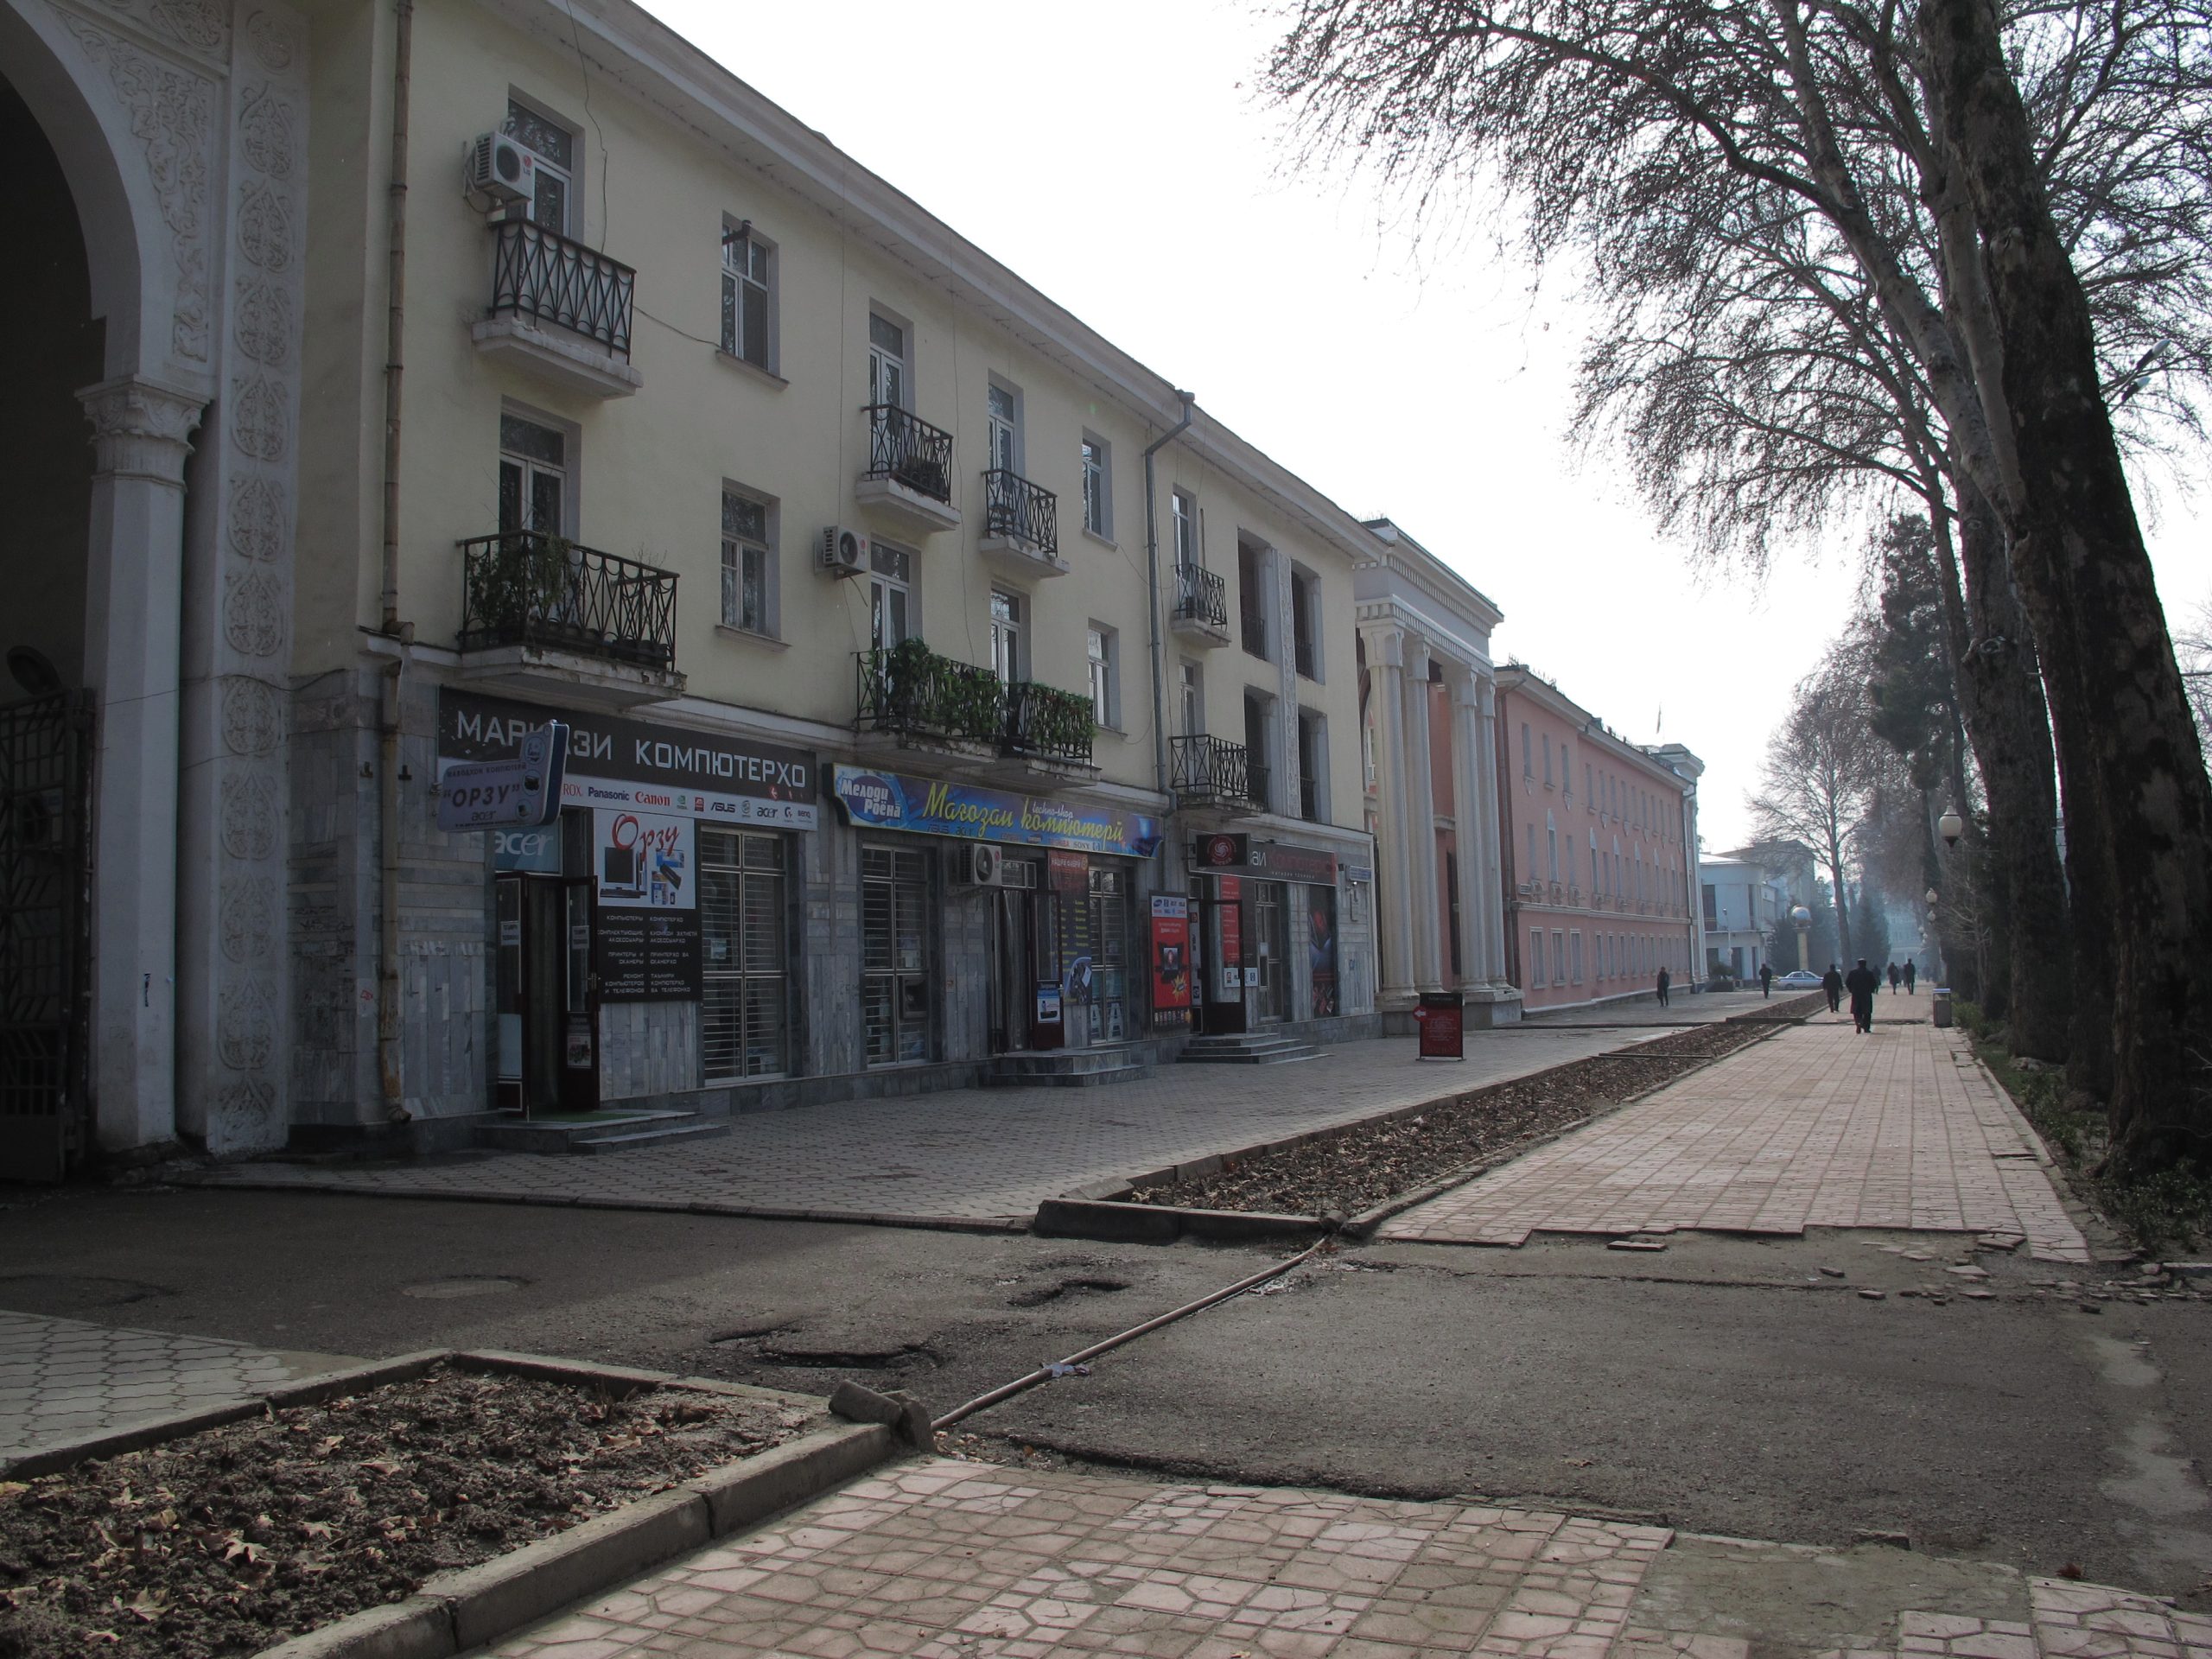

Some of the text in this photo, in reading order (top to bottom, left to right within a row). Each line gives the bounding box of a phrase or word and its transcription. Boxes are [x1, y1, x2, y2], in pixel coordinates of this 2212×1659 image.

[457, 710, 612, 760] МАРЗИ
[588, 786, 630, 801] Panasonic
[635, 791, 671, 806] Canon
[710, 802, 736, 813] ASUS
[757, 807, 778, 818] acer
[841, 779, 889, 803] Мелоди
[494, 830, 553, 855] acer
[612, 814, 679, 861] Орзу
